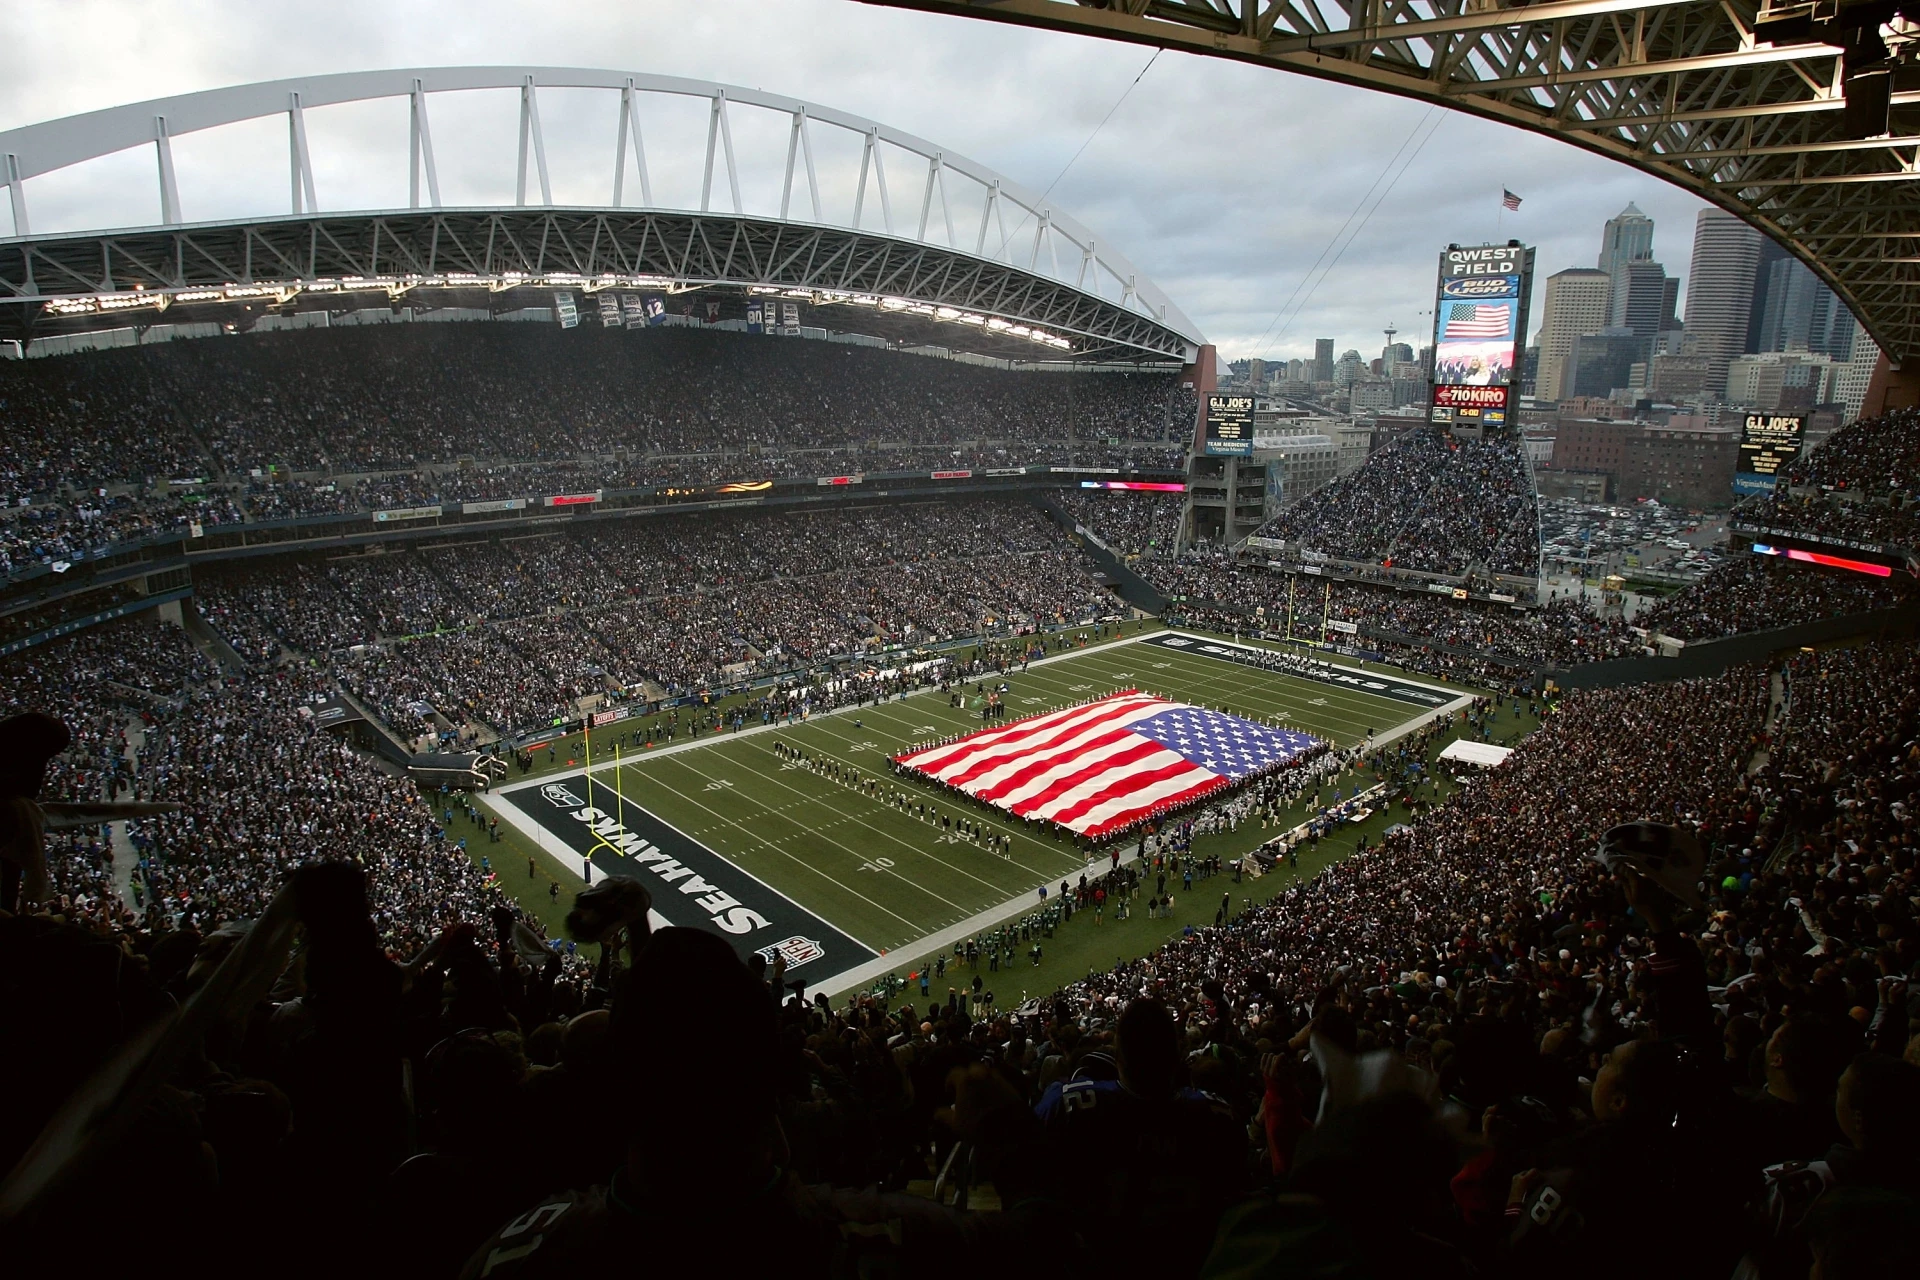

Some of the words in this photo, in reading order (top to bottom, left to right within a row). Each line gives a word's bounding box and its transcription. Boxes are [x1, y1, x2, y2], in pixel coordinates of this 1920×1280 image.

[1449, 248, 1520, 263] QWEST
[1453, 262, 1514, 275] FIELD
[1453, 285, 1512, 295] LIGHT
[1462, 279, 1506, 288] BUD
[646, 301, 664, 319] 12
[747, 310, 763, 324] 80
[1451, 389, 1470, 401] 710
[1470, 390, 1504, 402] KIRO
[1210, 397, 1225, 408] G.I.
[1226, 397, 1252, 408] JOE'S
[1460, 408, 1480, 417] 15:00
[1745, 415, 1765, 430] G.I.
[1766, 416, 1800, 432] JOE'S
[1760, 480, 1776, 489] Maso
[1, 638, 31, 655] THE
[44, 622, 80, 640] 12TH
[94, 608, 124, 623] MAN
[594, 711, 615, 723] LAYOFFS
[568, 805, 773, 935] SEAHAWKS
[863, 857, 895, 873] 10
[782, 939, 818, 962] NFL
